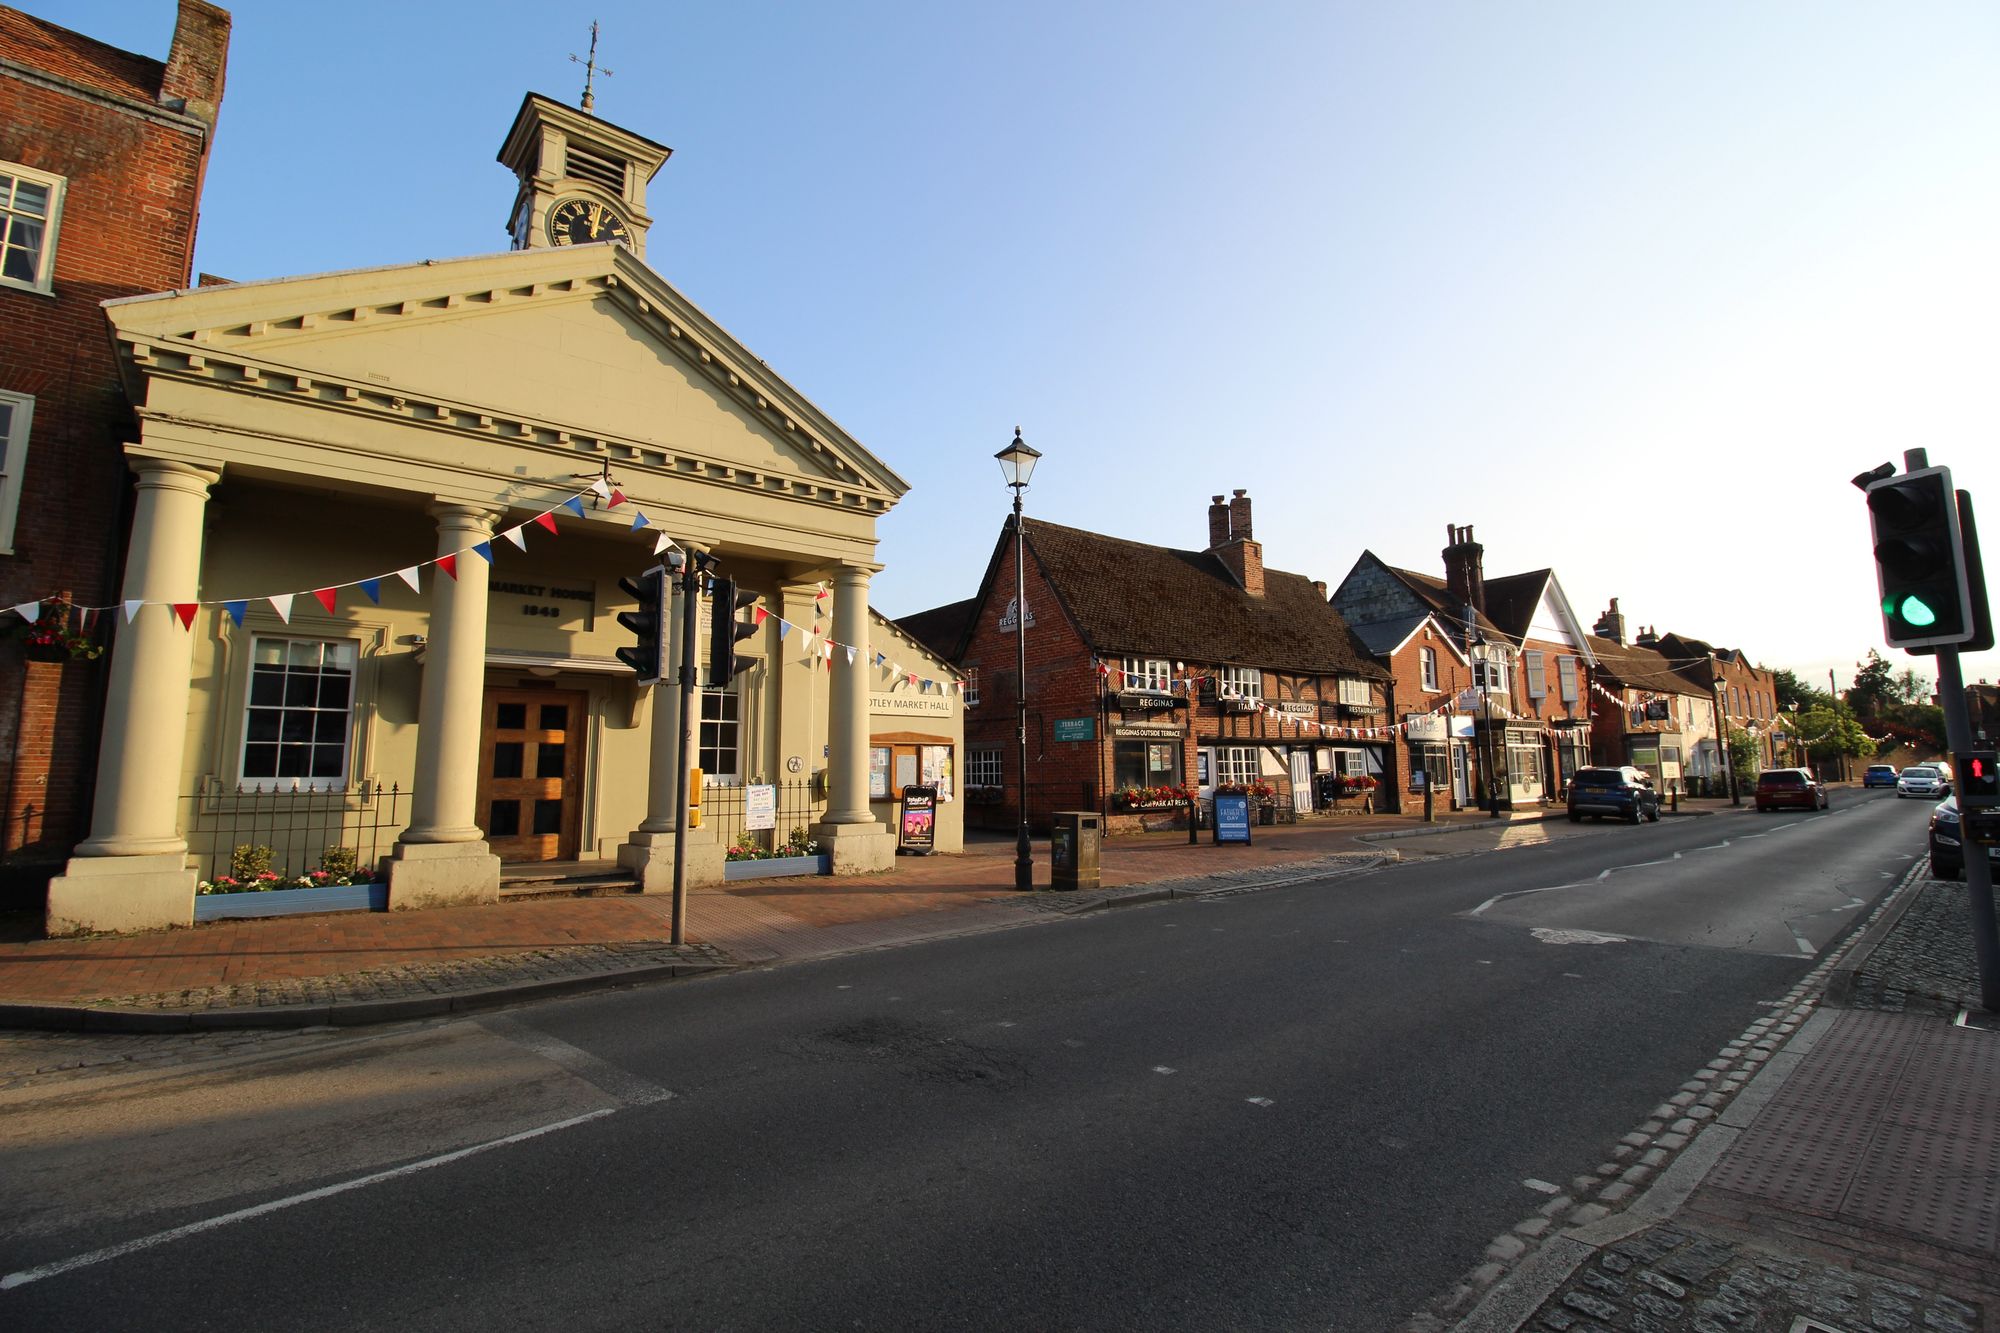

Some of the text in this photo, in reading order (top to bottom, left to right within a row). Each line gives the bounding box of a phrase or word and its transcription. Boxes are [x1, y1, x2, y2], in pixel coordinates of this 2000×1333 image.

[488, 581, 546, 597] MARKET
[522, 604, 560, 618] 1848
[893, 700, 928, 710] MARKET
[930, 702, 950, 711] HALL
[1139, 698, 1174, 707] REGGINAS
[1283, 704, 1315, 713] REGGINAS
[1348, 706, 1380, 714] RESTAURANT
[1152, 799, 1167, 807] PARK
[1174, 799, 1189, 807] REAR
